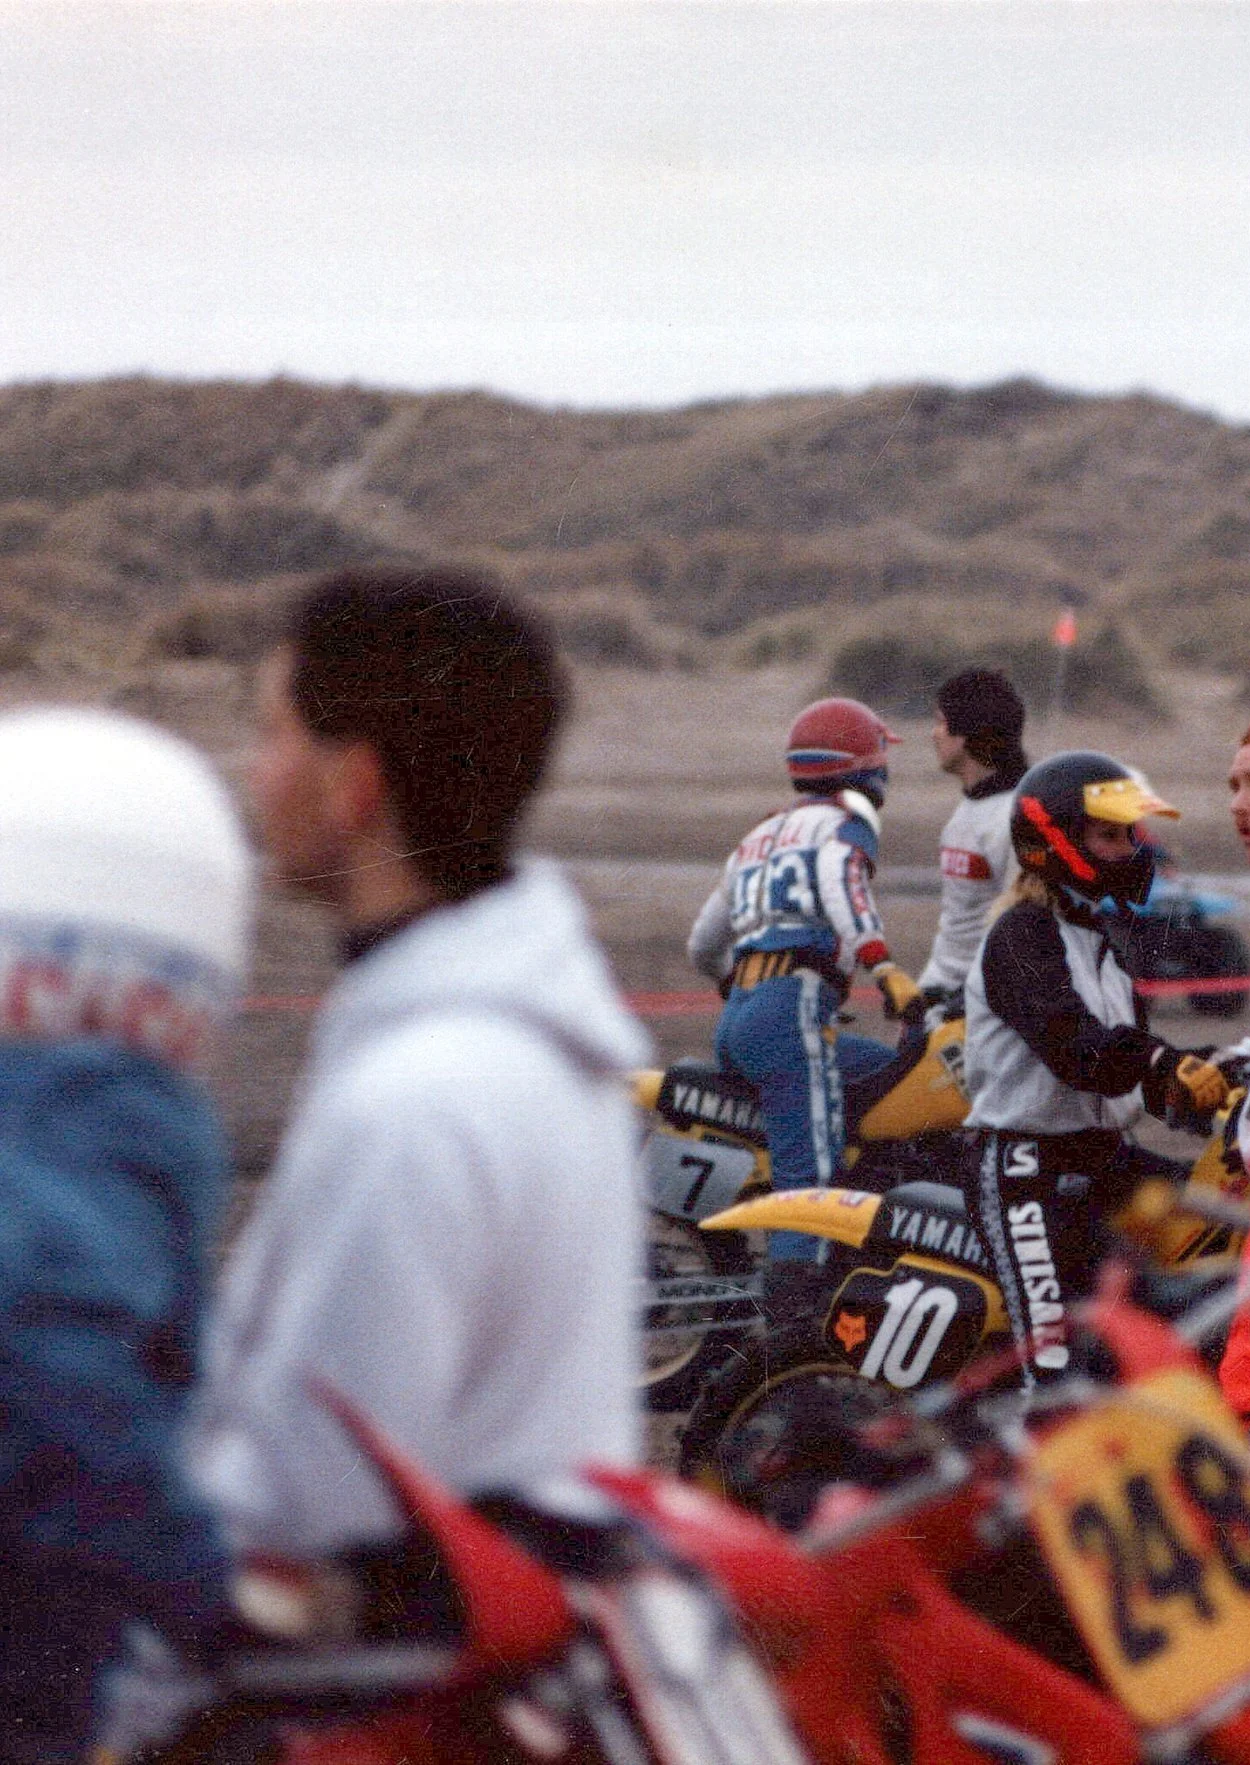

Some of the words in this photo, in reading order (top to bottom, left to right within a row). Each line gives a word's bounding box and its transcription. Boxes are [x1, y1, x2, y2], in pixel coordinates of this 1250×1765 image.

[680, 1154, 715, 1212] 7
[889, 1205, 989, 1267] YAMAH
[859, 1278, 958, 1388] 10
